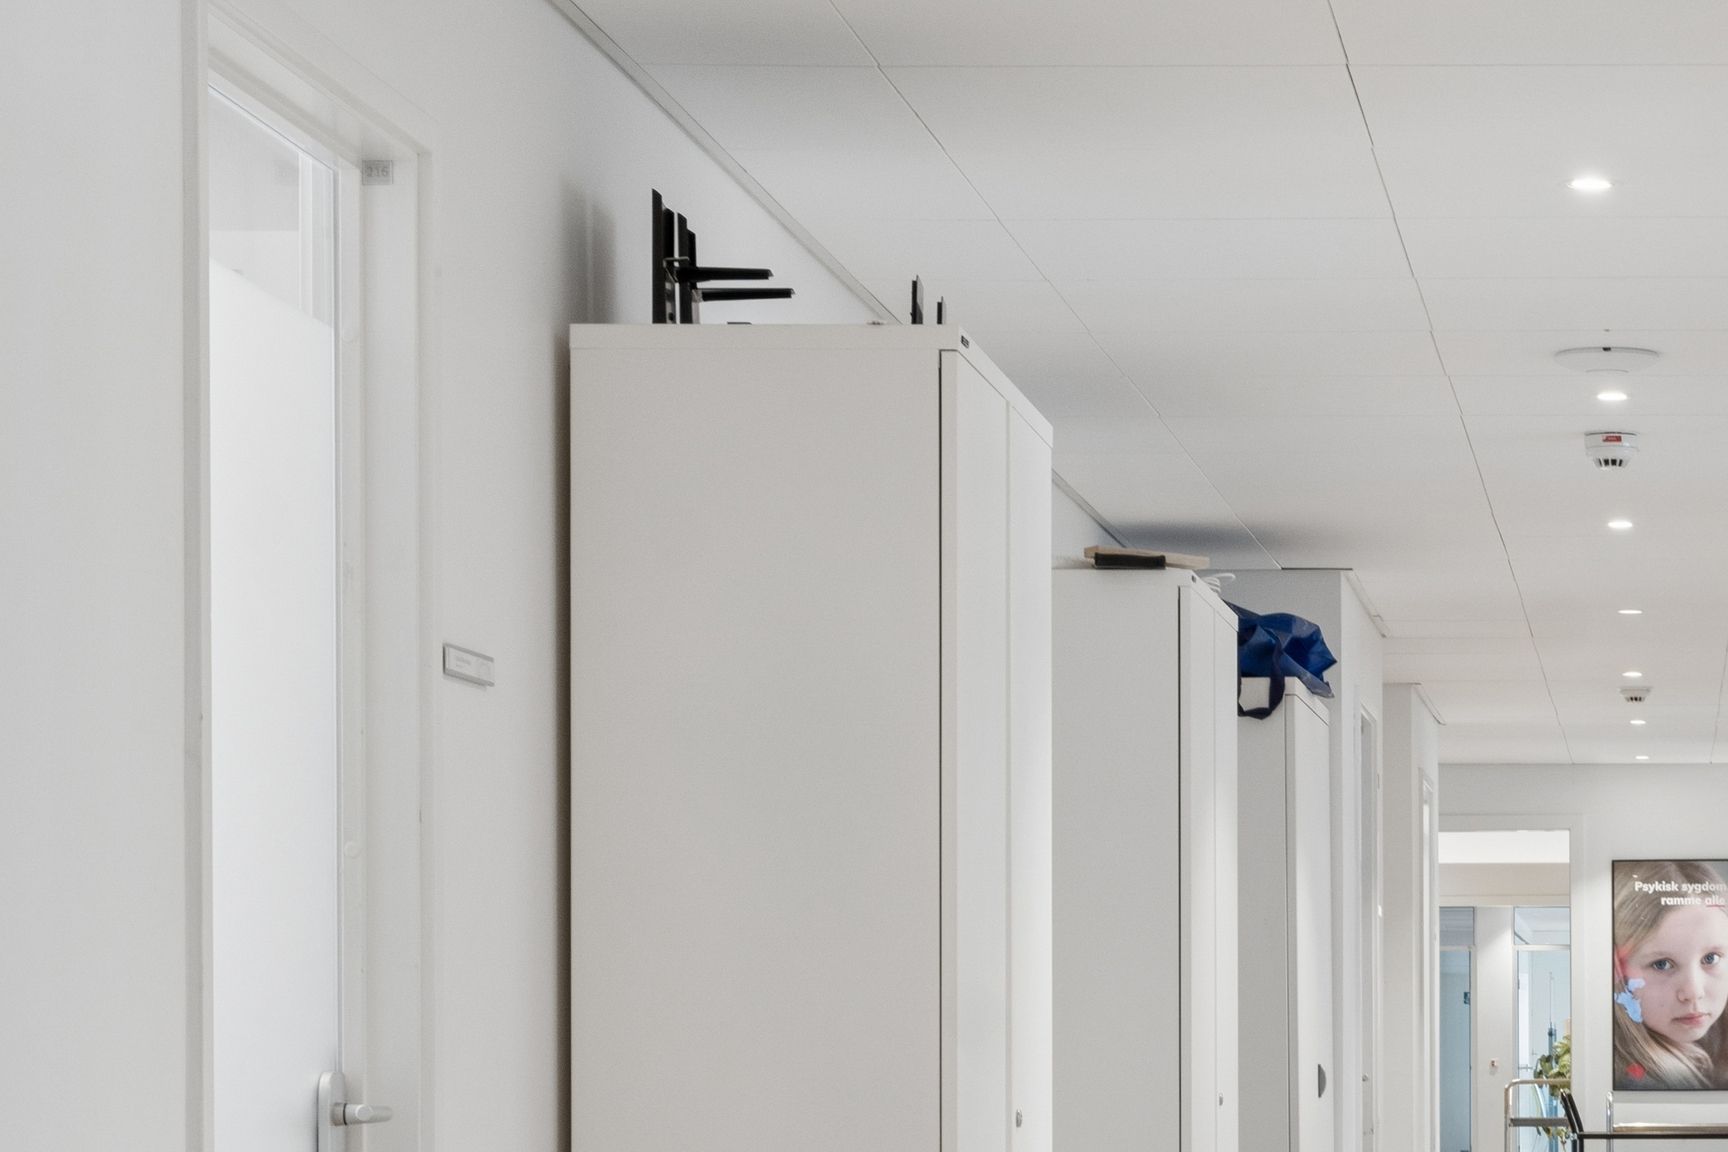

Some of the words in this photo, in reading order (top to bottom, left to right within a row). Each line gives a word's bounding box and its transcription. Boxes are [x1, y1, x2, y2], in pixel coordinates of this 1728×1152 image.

[1634, 881, 1679, 894] Psykisk
[1681, 881, 1727, 894] sygdom
[1661, 896, 1702, 906] ramme
[1705, 894, 1726, 906] alle
